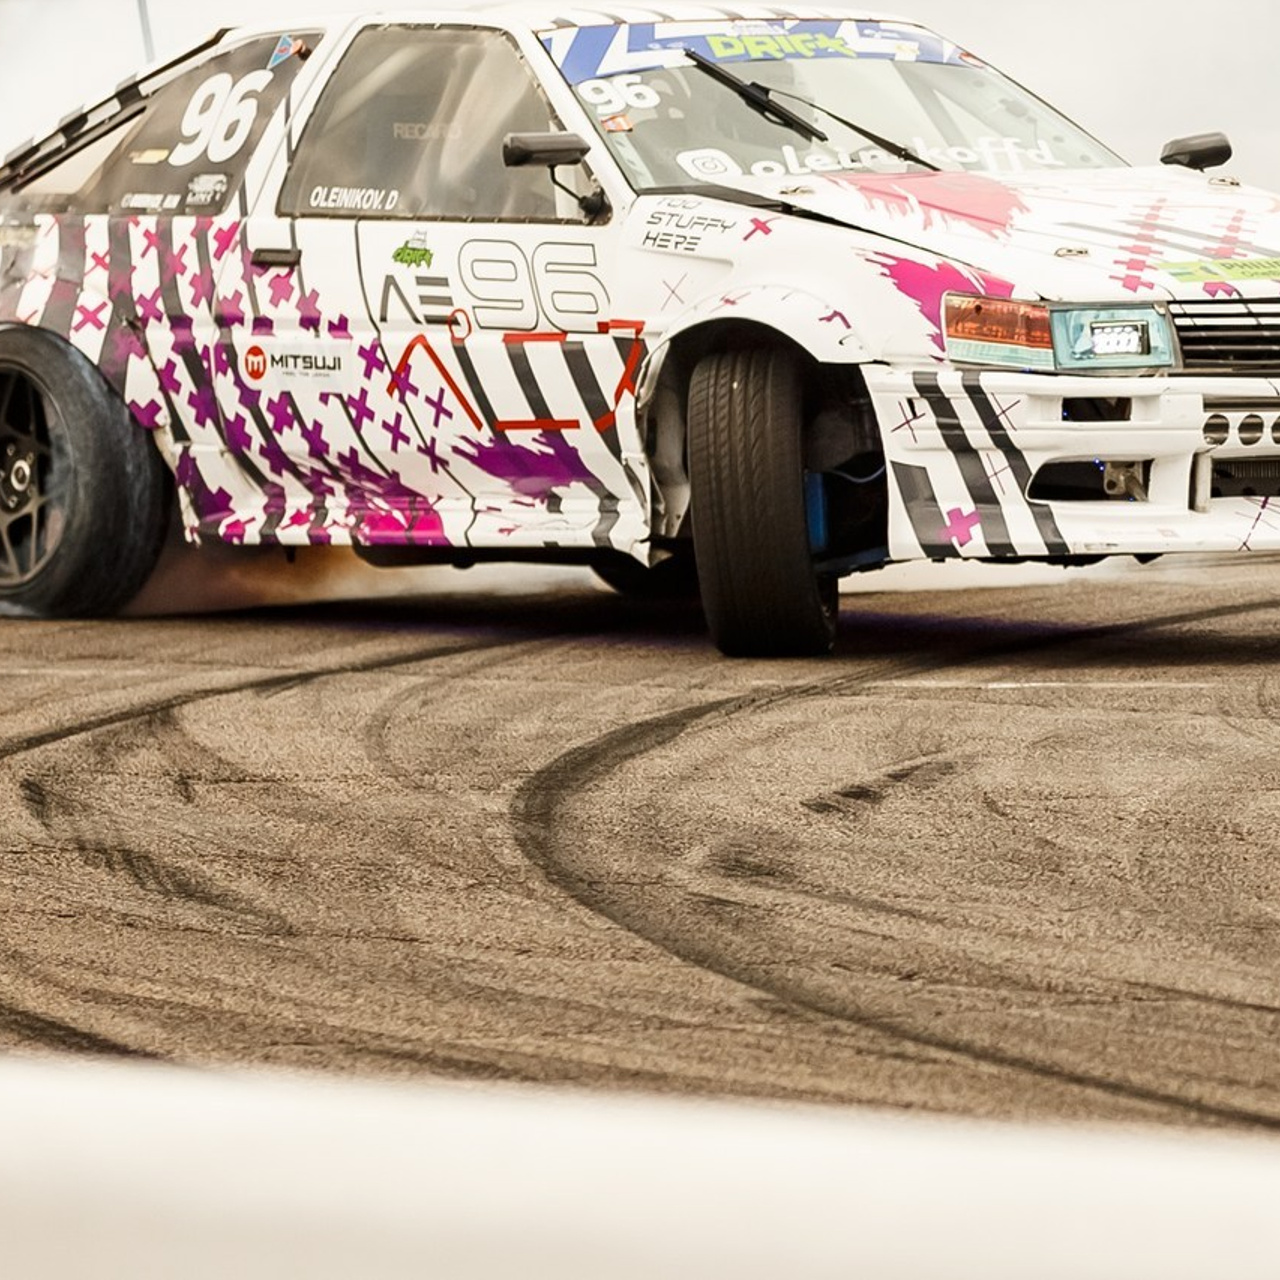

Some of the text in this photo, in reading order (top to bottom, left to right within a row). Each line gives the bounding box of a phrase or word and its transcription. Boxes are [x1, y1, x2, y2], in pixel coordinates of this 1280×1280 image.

[578, 74, 661, 116] 96
[168, 70, 274, 166] 96
[646, 211, 737, 233] STUFFY
[458, 239, 611, 334] 96
[270, 354, 341, 371] MITSUJI
